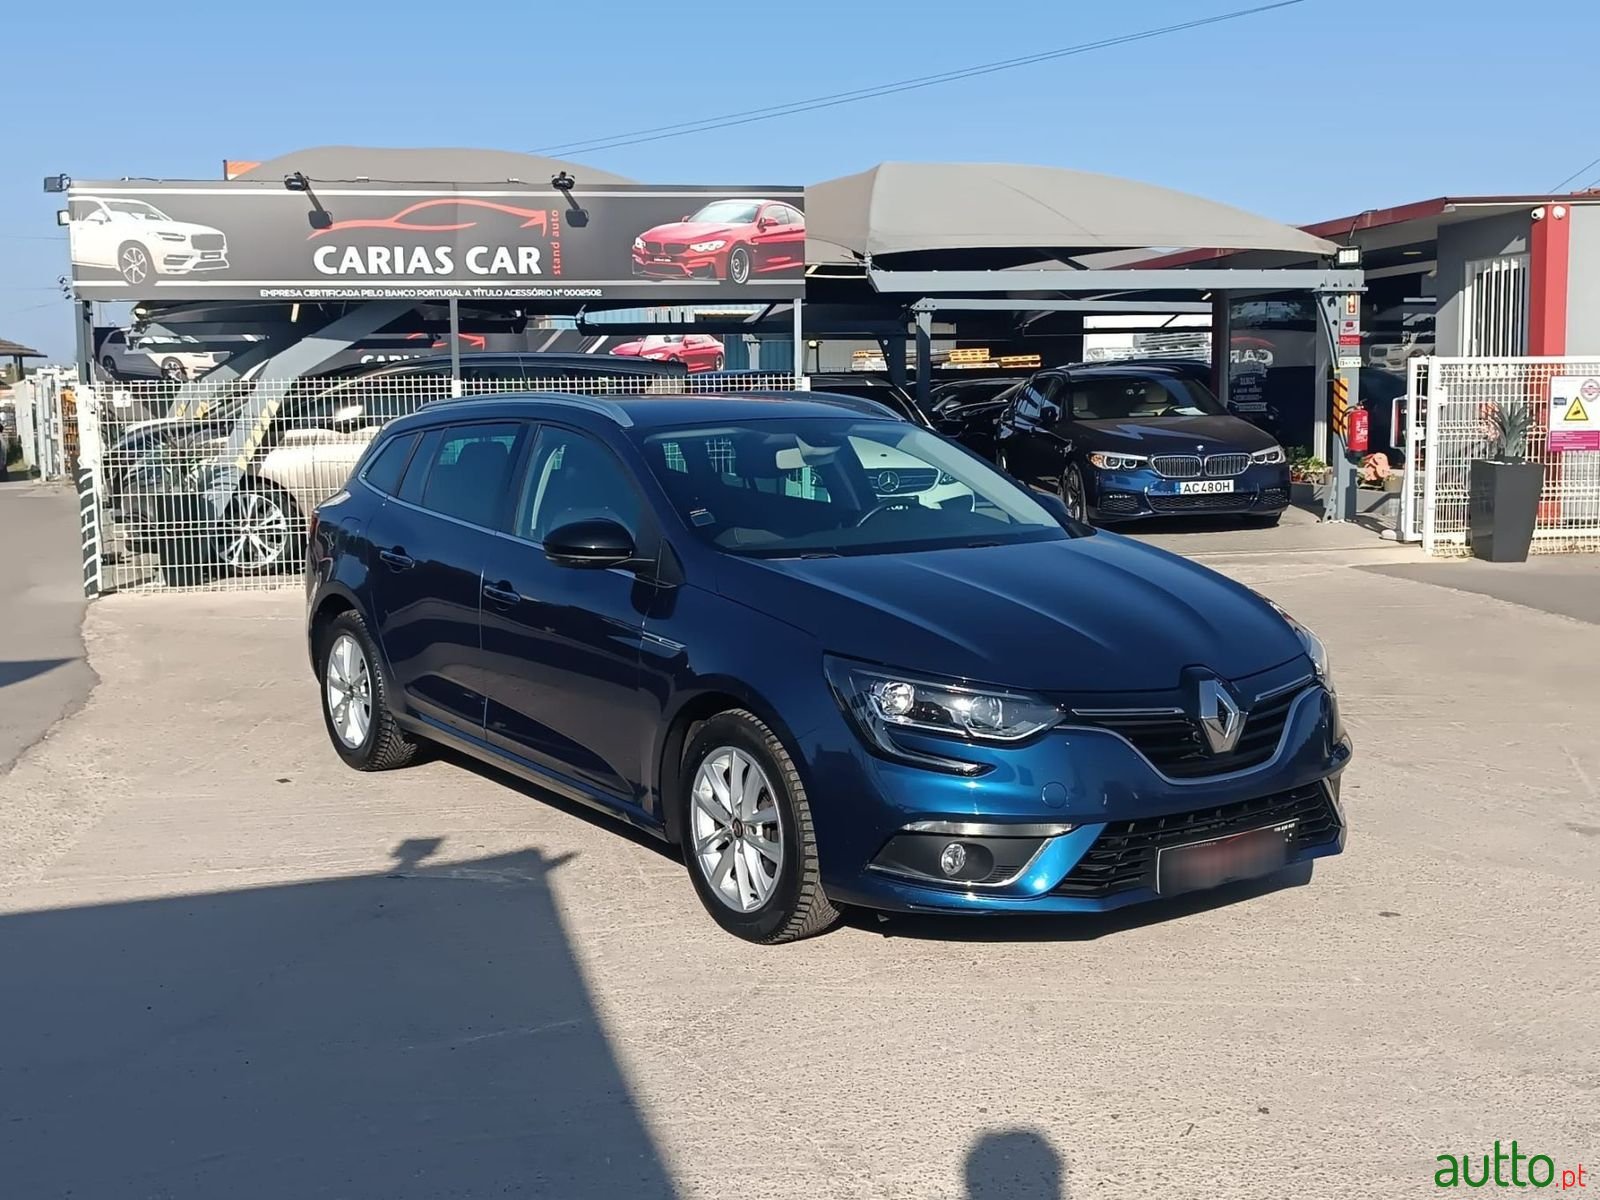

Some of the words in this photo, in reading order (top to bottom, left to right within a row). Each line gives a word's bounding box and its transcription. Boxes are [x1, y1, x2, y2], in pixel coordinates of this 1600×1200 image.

[551, 210, 561, 237] auto
[313, 245, 454, 275] CARIAS
[465, 246, 542, 275] CAR
[551, 242, 561, 276] stand
[260, 289, 302, 297] EMPRESA
[303, 289, 360, 297] CERTIFICADA
[361, 289, 384, 297] PELO
[385, 289, 416, 297] BANCO
[417, 289, 463, 297] PORTUGAL
[464, 289, 470, 297] A
[473, 287, 502, 297] TÍTULO
[503, 287, 552, 297] ACESSÓRIO
